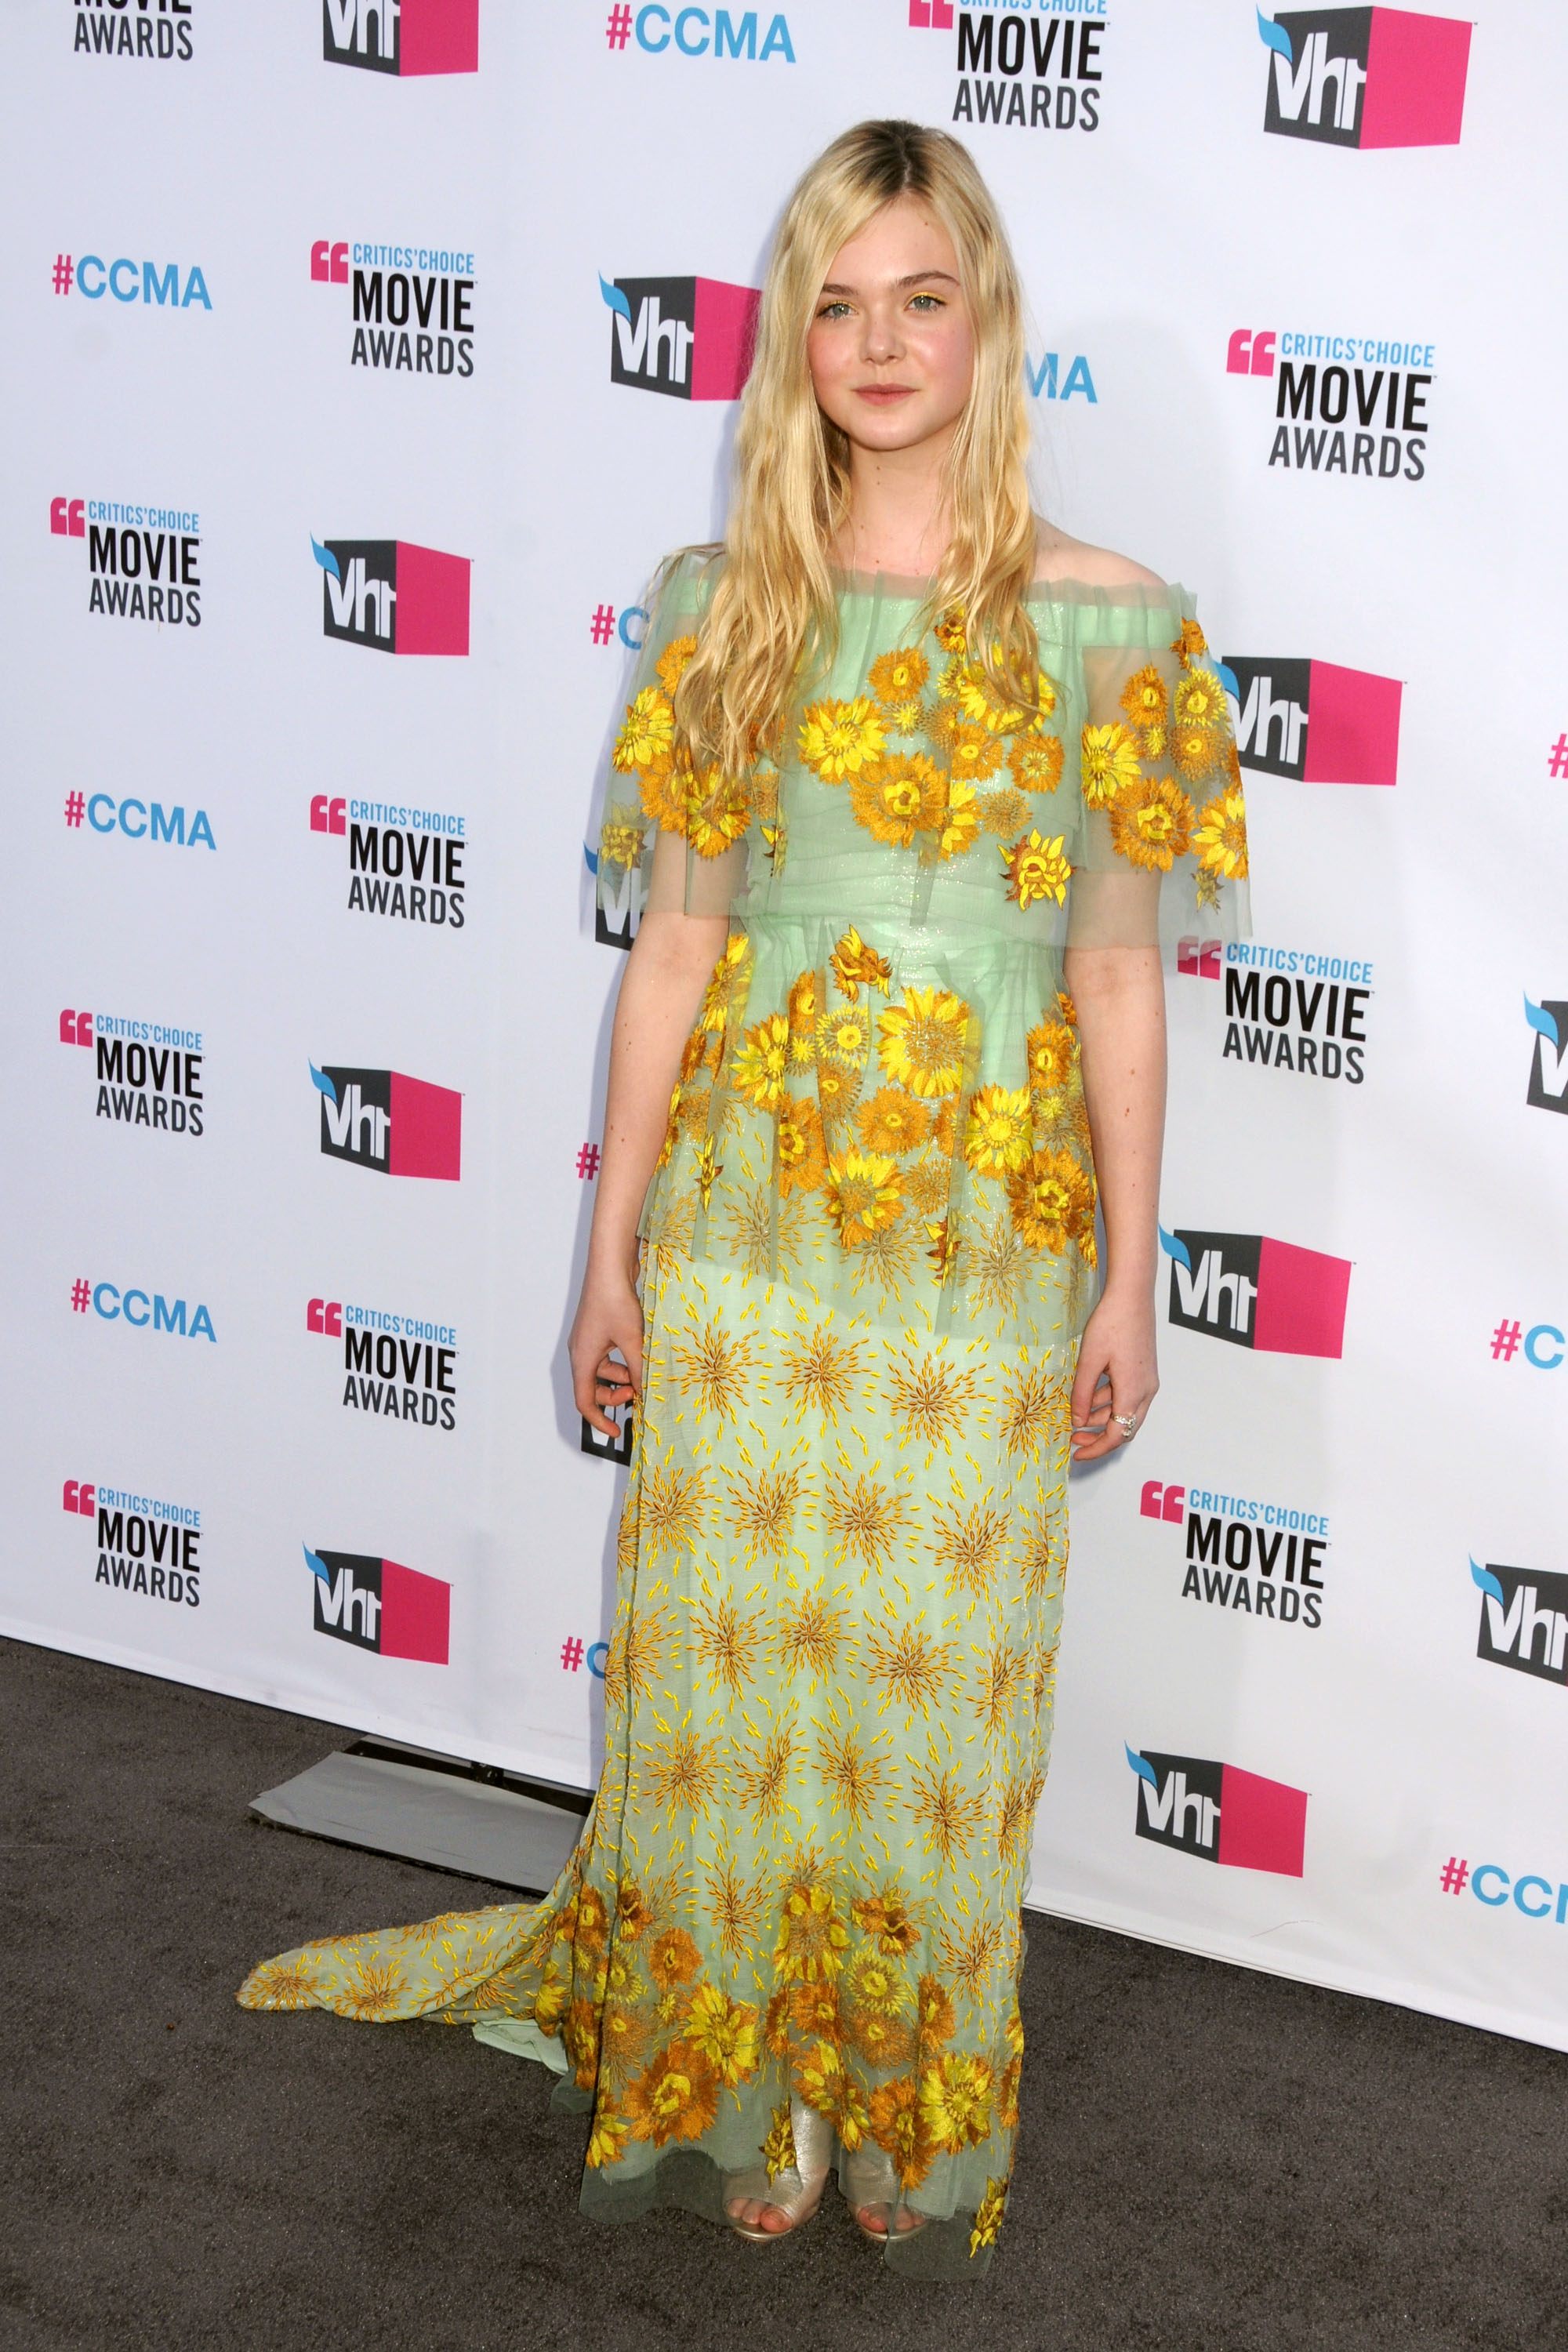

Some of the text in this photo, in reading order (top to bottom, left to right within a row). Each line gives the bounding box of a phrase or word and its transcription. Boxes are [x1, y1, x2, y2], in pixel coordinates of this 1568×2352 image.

[74, 13, 193, 61] AWARDS
[606, 3, 797, 64] #CCMA
[958, 13, 1105, 81] MOVIE
[953, 79, 1099, 131] AWARDS
[53, 254, 213, 311] #CCMA
[354, 270, 474, 332] MOVIE
[351, 328, 473, 377] AWARDS
[1276, 362, 1432, 432] MOVIE
[1269, 426, 1425, 481] AWARDS
[89, 525, 200, 586] MOVIE
[89, 579, 201, 626] AWARDS
[65, 791, 217, 851] #CCMA
[350, 824, 464, 888] MOVIE
[348, 876, 464, 927] AWARDS
[1226, 967, 1370, 1042] MOVIE
[97, 1036, 202, 1099] MOVIE
[1223, 1022, 1363, 1083] AWARDS
[96, 1085, 203, 1136] AWARDS
[71, 1279, 217, 1343] #CCMA
[346, 1327, 456, 1394] MOVIE
[343, 1375, 455, 1430] AWARDS
[98, 1508, 200, 1573] MOVIE
[1186, 1512, 1327, 1589] MOVIE
[96, 1553, 199, 1607] AWARDS
[1181, 1565, 1322, 1628] AWARDS
